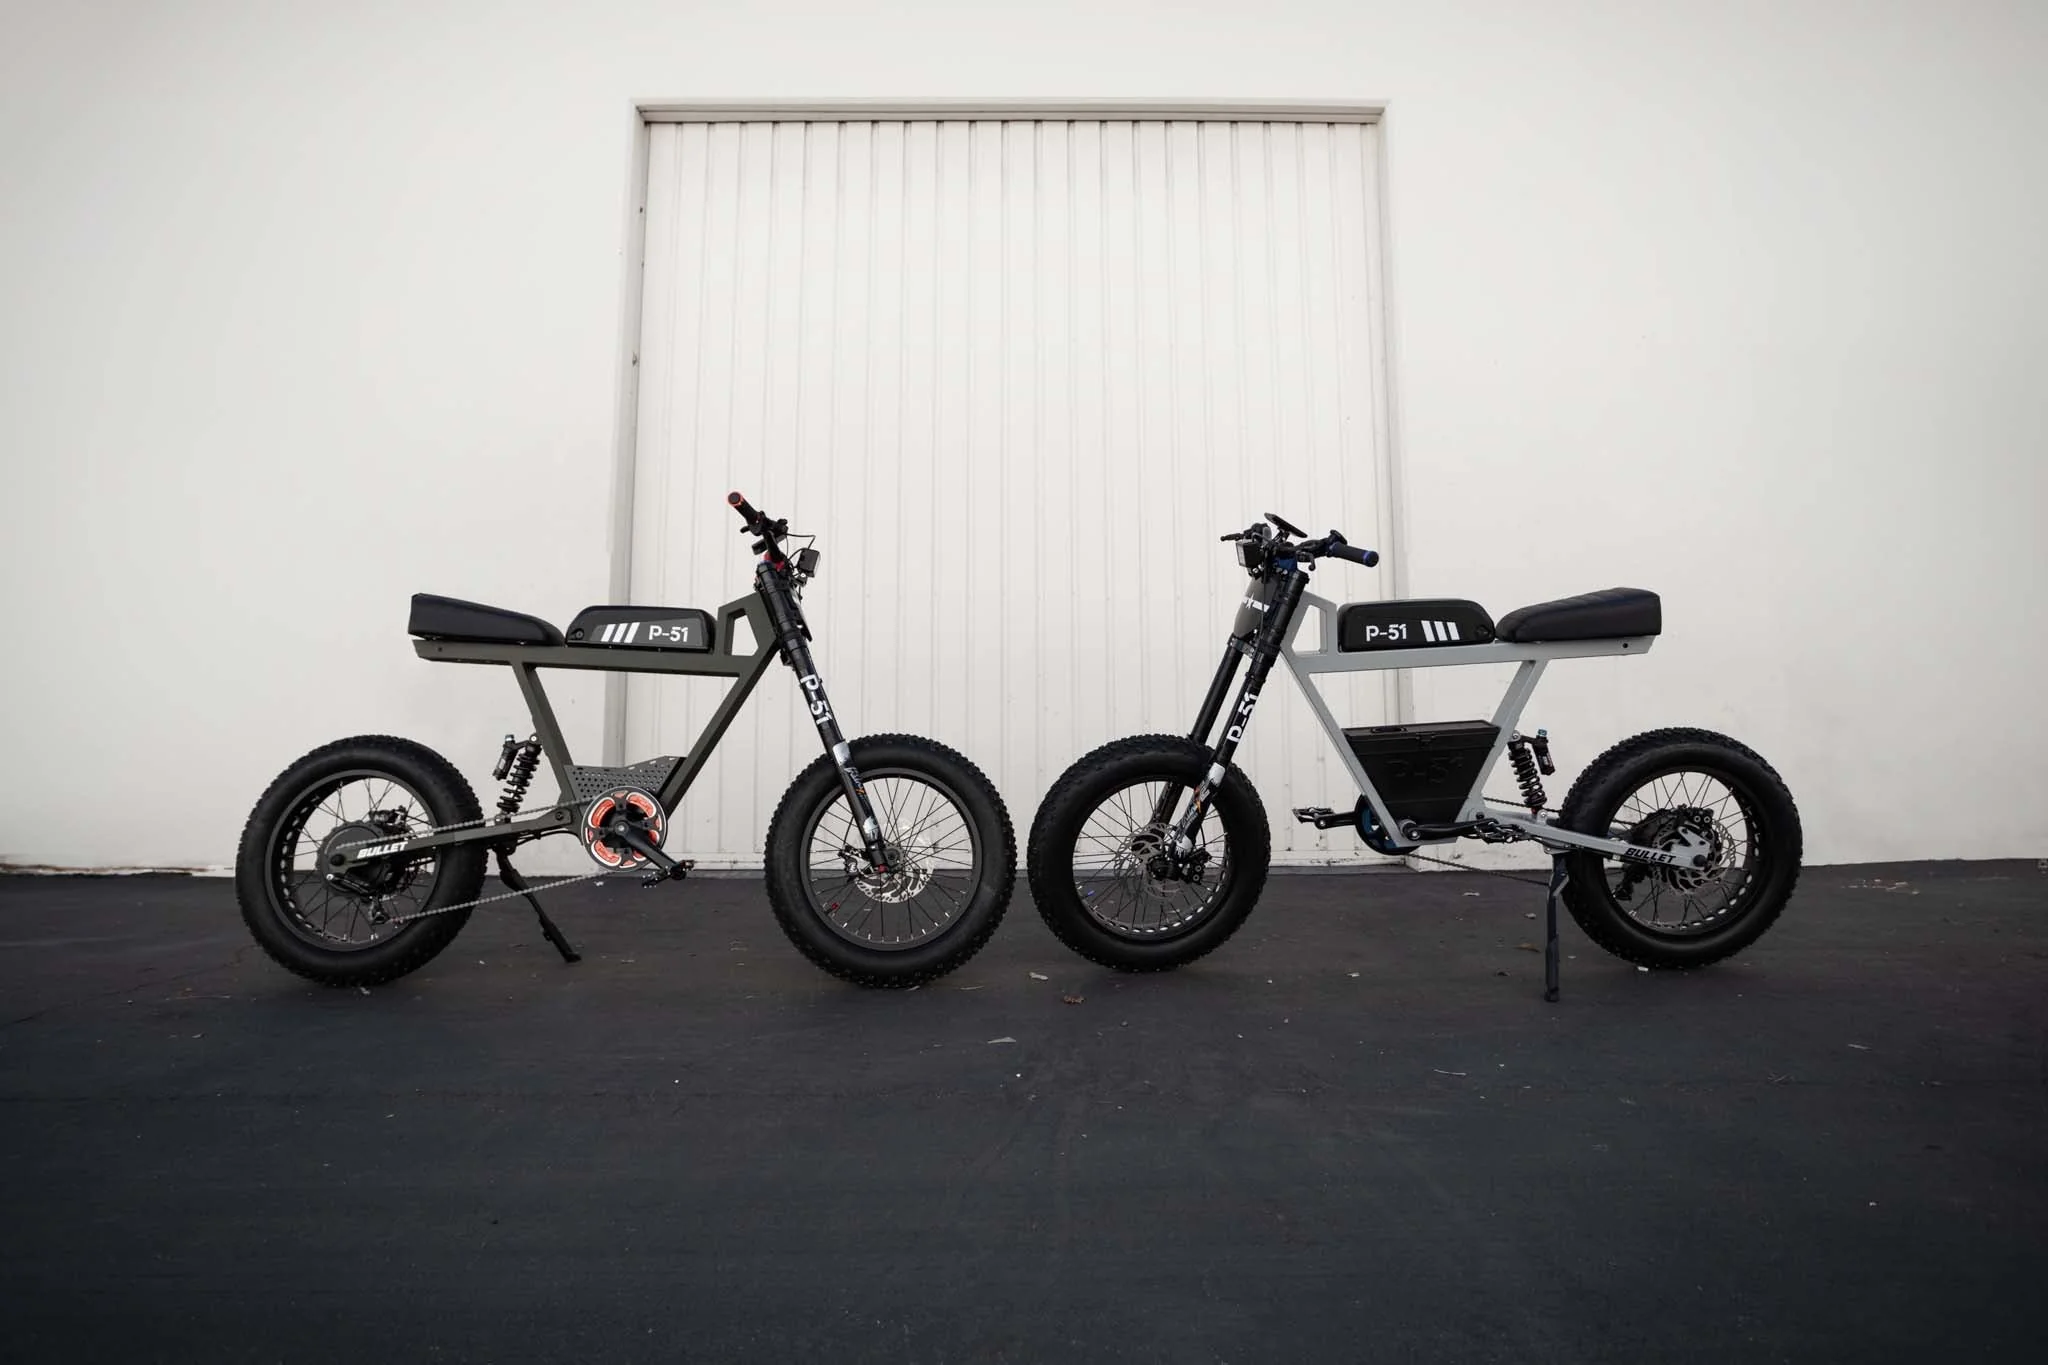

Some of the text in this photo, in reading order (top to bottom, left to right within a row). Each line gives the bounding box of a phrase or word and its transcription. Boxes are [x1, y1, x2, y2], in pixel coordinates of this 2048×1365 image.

[648, 625, 689, 642] P-51
[1366, 623, 1407, 642] P-51
[800, 674, 833, 725] P-51
[1226, 691, 1259, 743] P-51
[356, 841, 408, 859] BULLET
[1624, 847, 1677, 863] BULLET
